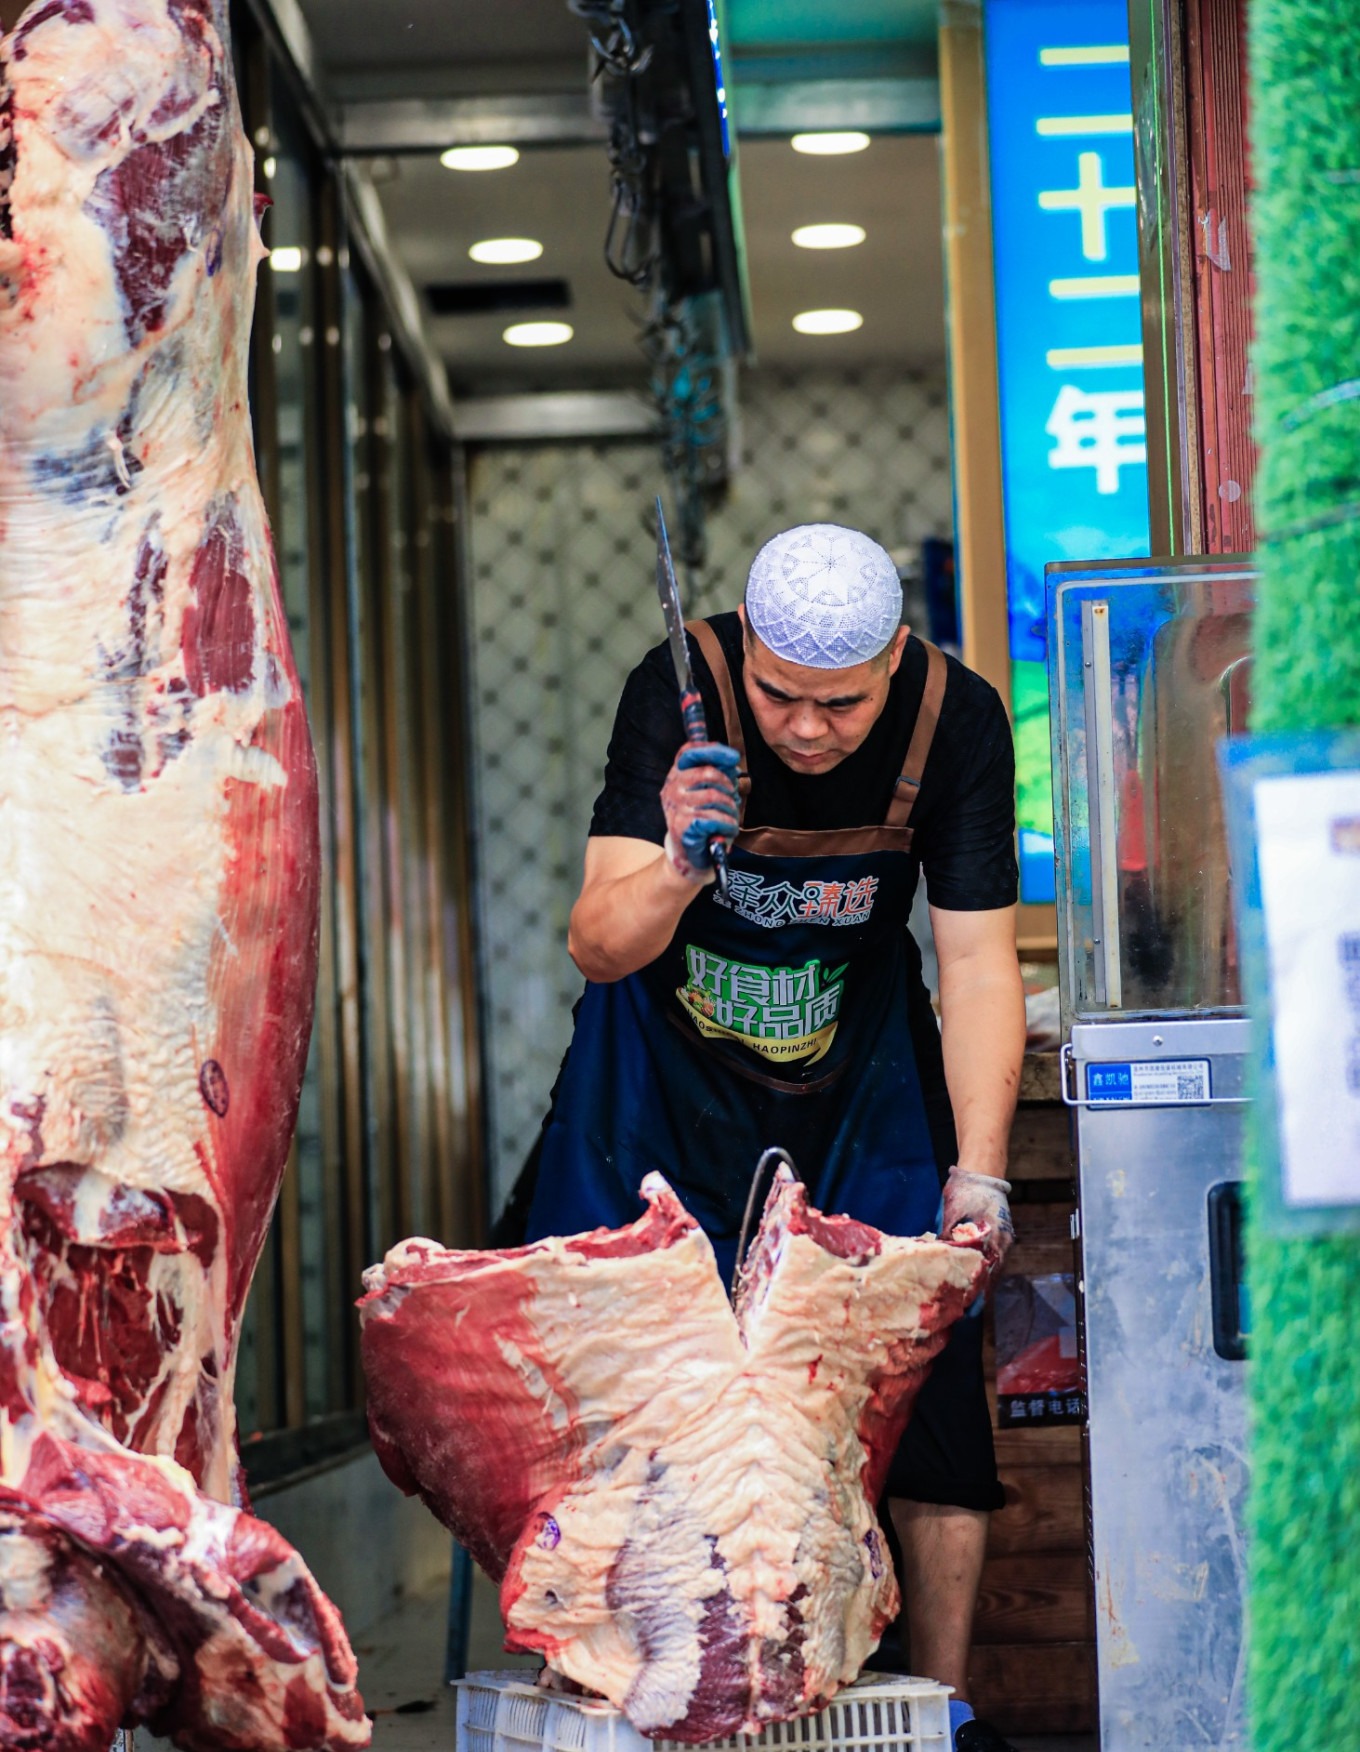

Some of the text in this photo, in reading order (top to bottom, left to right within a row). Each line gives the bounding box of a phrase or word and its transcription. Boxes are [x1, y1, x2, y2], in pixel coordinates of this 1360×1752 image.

[1036, 45, 1147, 495] 二十二年
[832, 910, 871, 927] XUAN
[690, 949, 816, 1005] 好食材
[716, 985, 840, 1039] 好品质
[753, 1038, 818, 1055] HAOPINZHI
[1010, 1398, 1080, 1417] 监督电话
